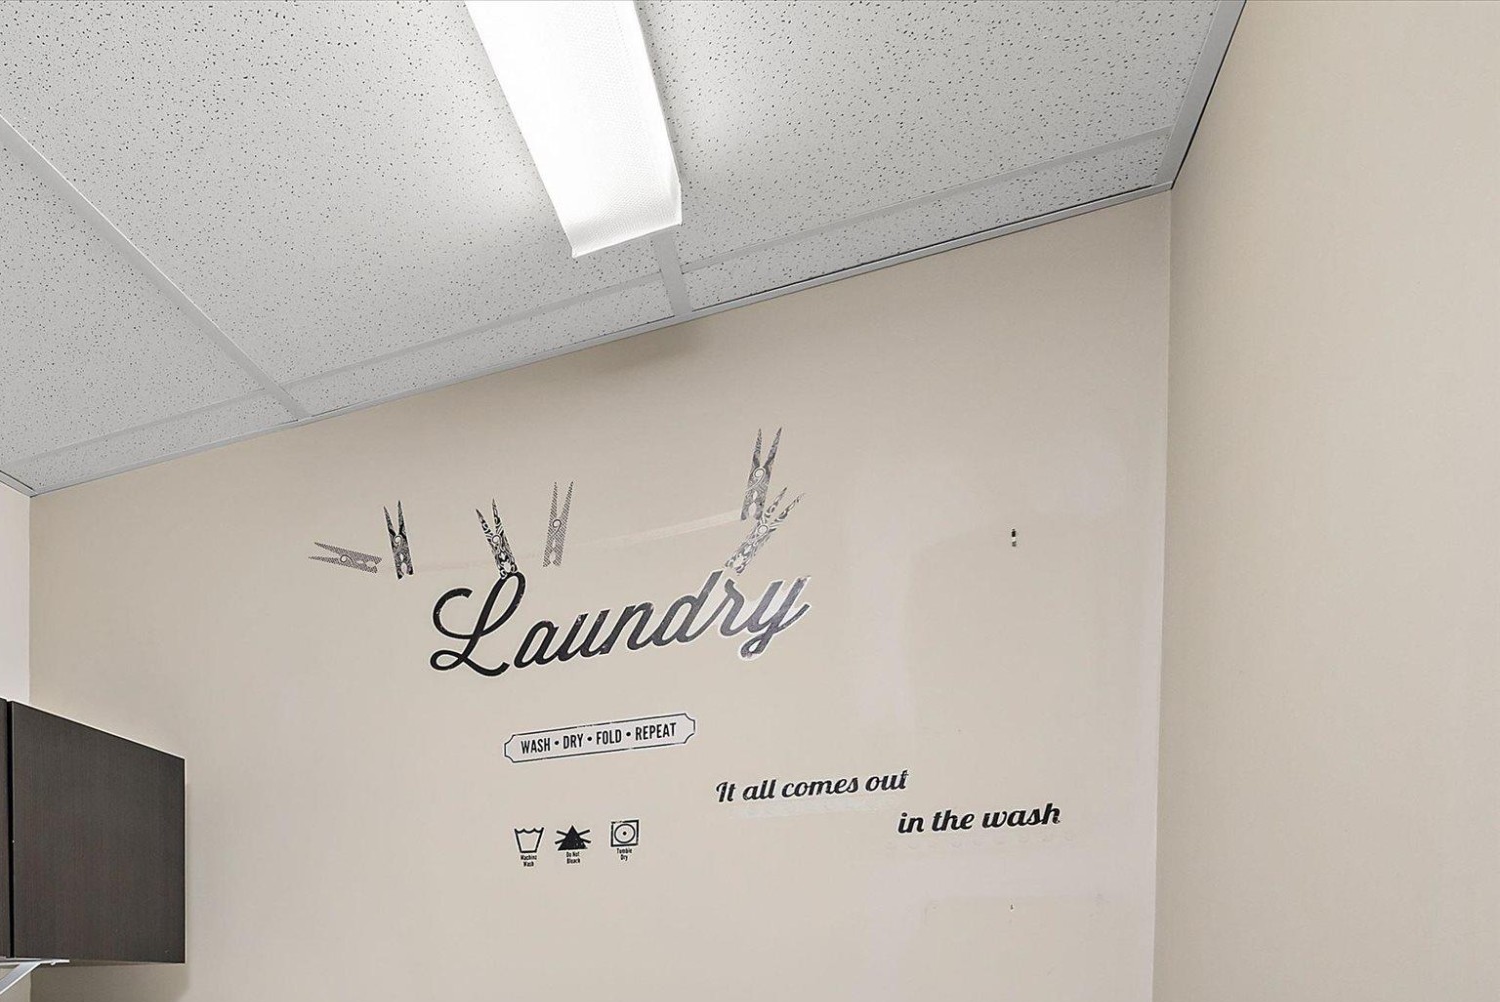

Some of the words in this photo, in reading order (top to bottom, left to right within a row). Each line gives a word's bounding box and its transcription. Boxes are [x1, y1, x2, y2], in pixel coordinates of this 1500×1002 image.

[430, 570, 811, 676] Laundry
[520, 738, 551, 754] WASH
[563, 733, 584, 749] DRY
[596, 729, 622, 745] FOLD
[635, 722, 677, 741] REPEAT
[716, 781, 736, 803] It
[743, 779, 776, 800] all
[782, 775, 858, 798] comes
[865, 770, 909, 792] out
[898, 812, 924, 833] in
[932, 809, 975, 831] the
[982, 803, 1061, 829] wash
